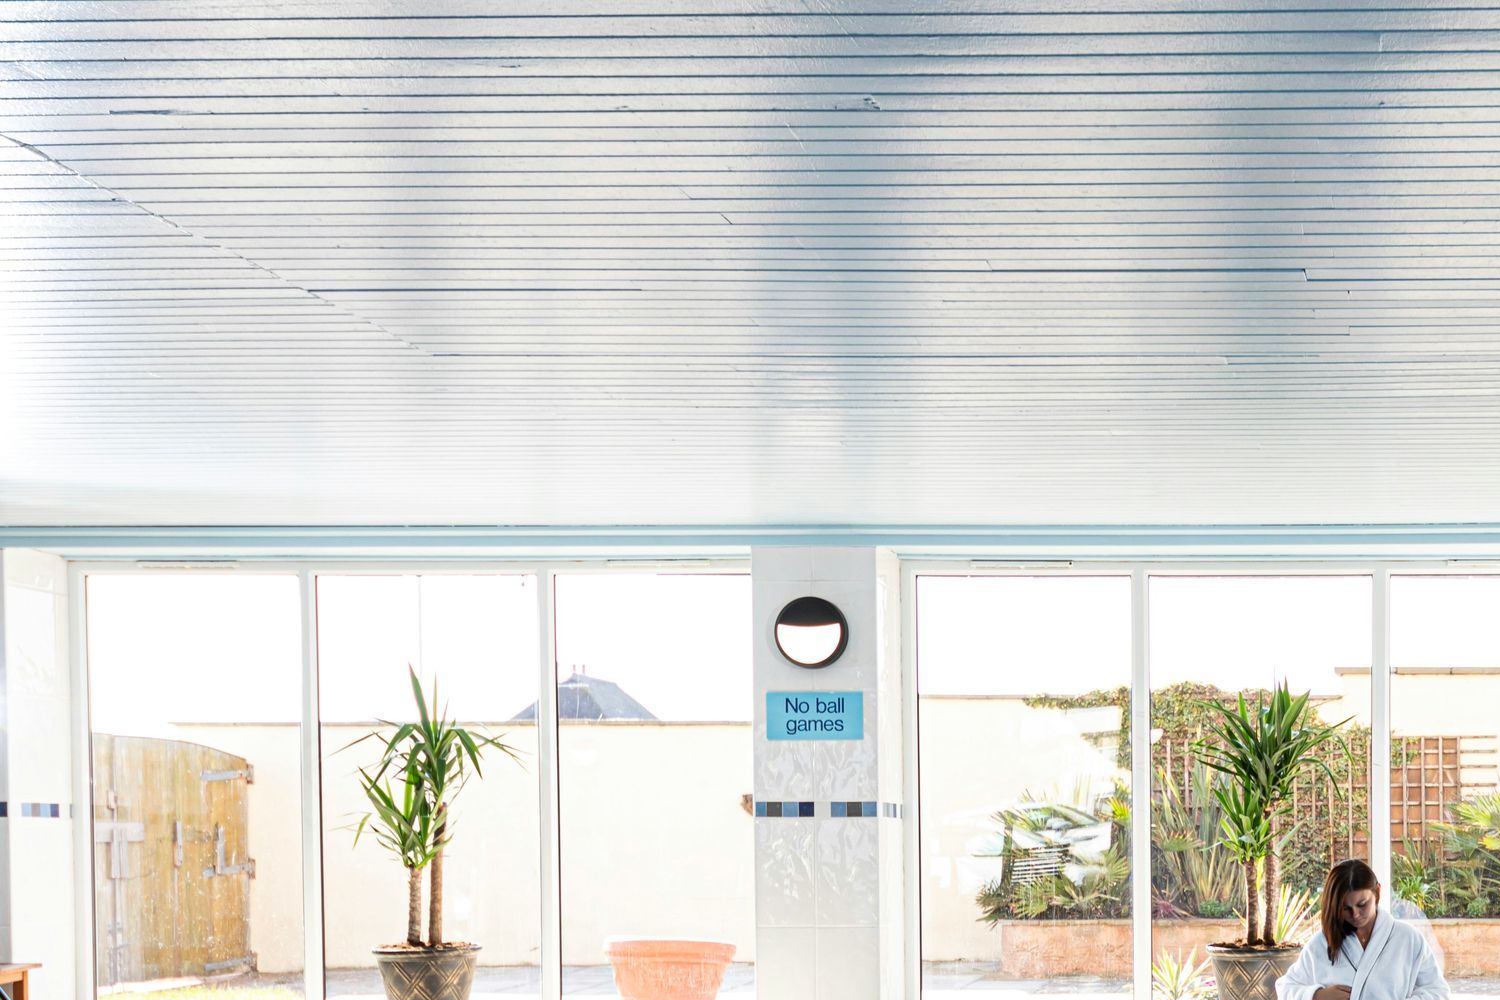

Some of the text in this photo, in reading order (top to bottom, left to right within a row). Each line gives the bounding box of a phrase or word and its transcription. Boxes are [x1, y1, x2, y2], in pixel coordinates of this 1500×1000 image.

[785, 698, 844, 714] No ball
[786, 718, 844, 735] games
